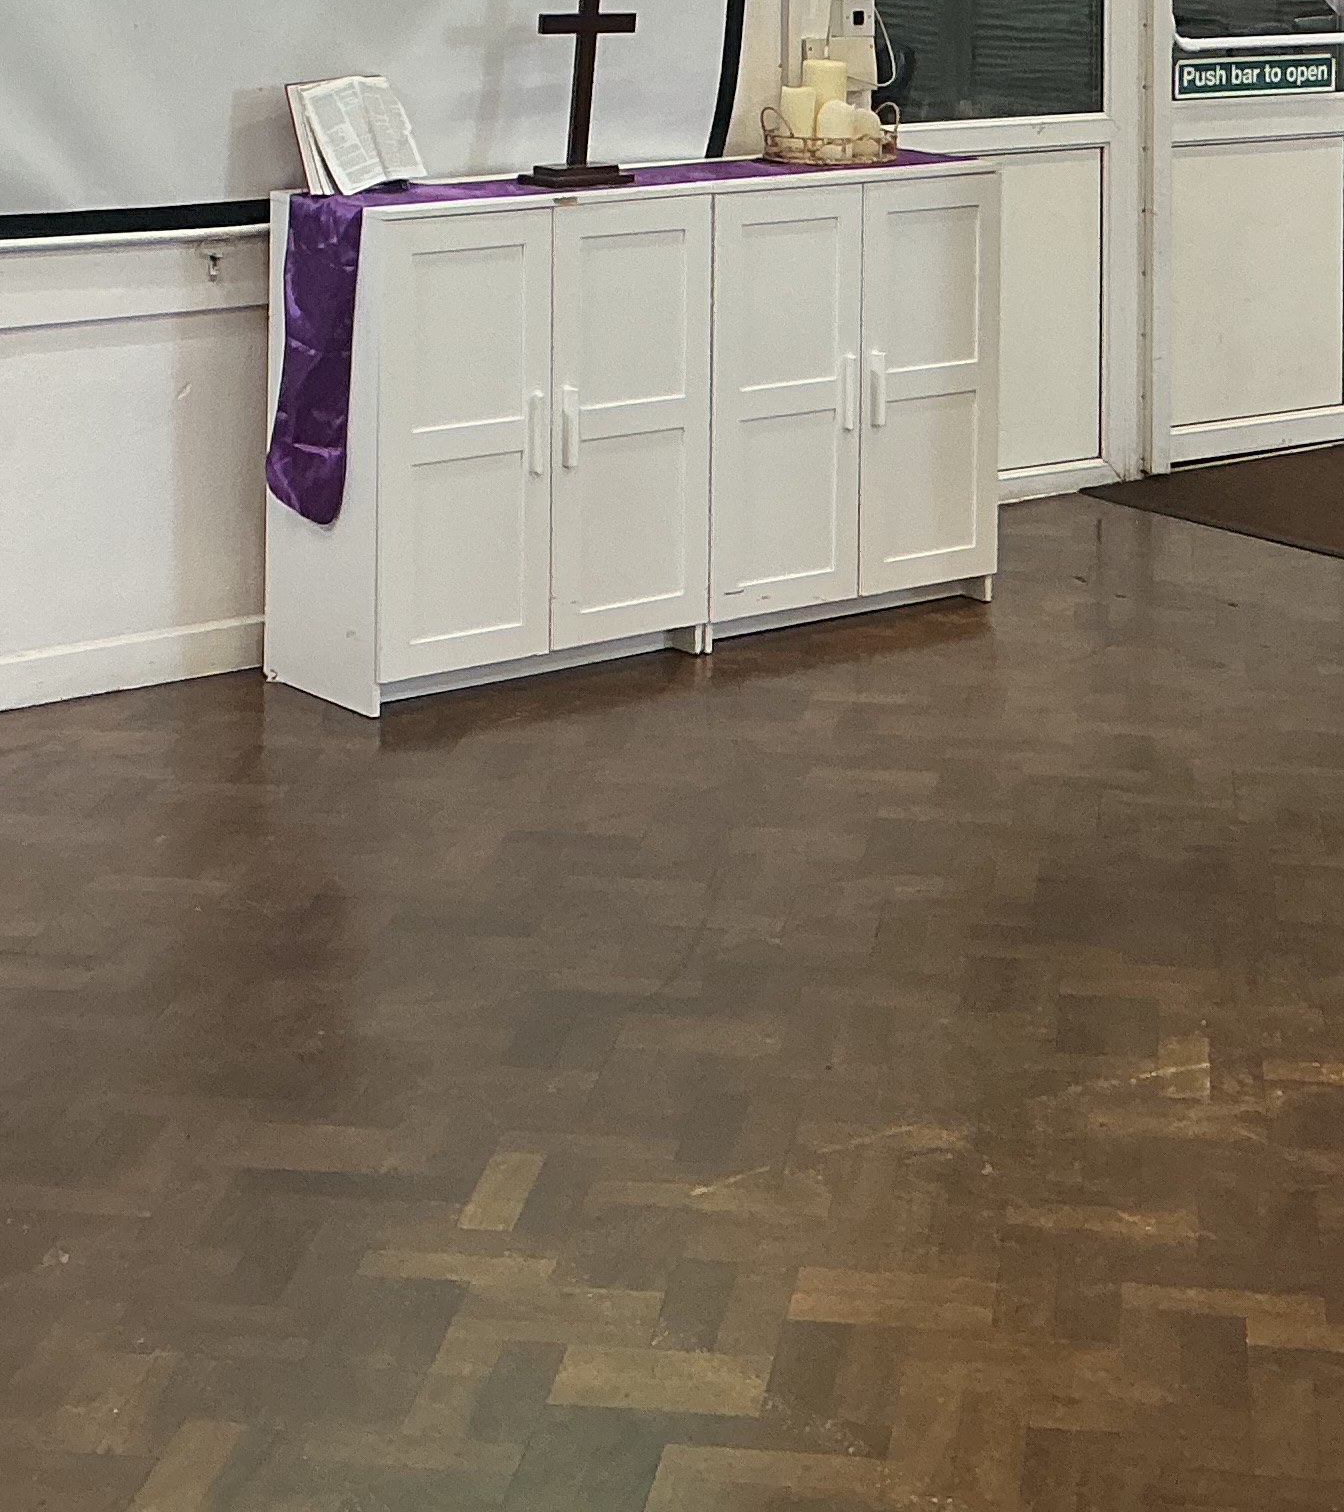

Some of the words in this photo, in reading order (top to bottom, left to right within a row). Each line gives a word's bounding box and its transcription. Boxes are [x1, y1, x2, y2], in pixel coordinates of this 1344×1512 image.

[1182, 65, 1227, 87] Push
[1231, 64, 1261, 85] bar
[1264, 63, 1282, 83] to
[1286, 64, 1329, 86] open
